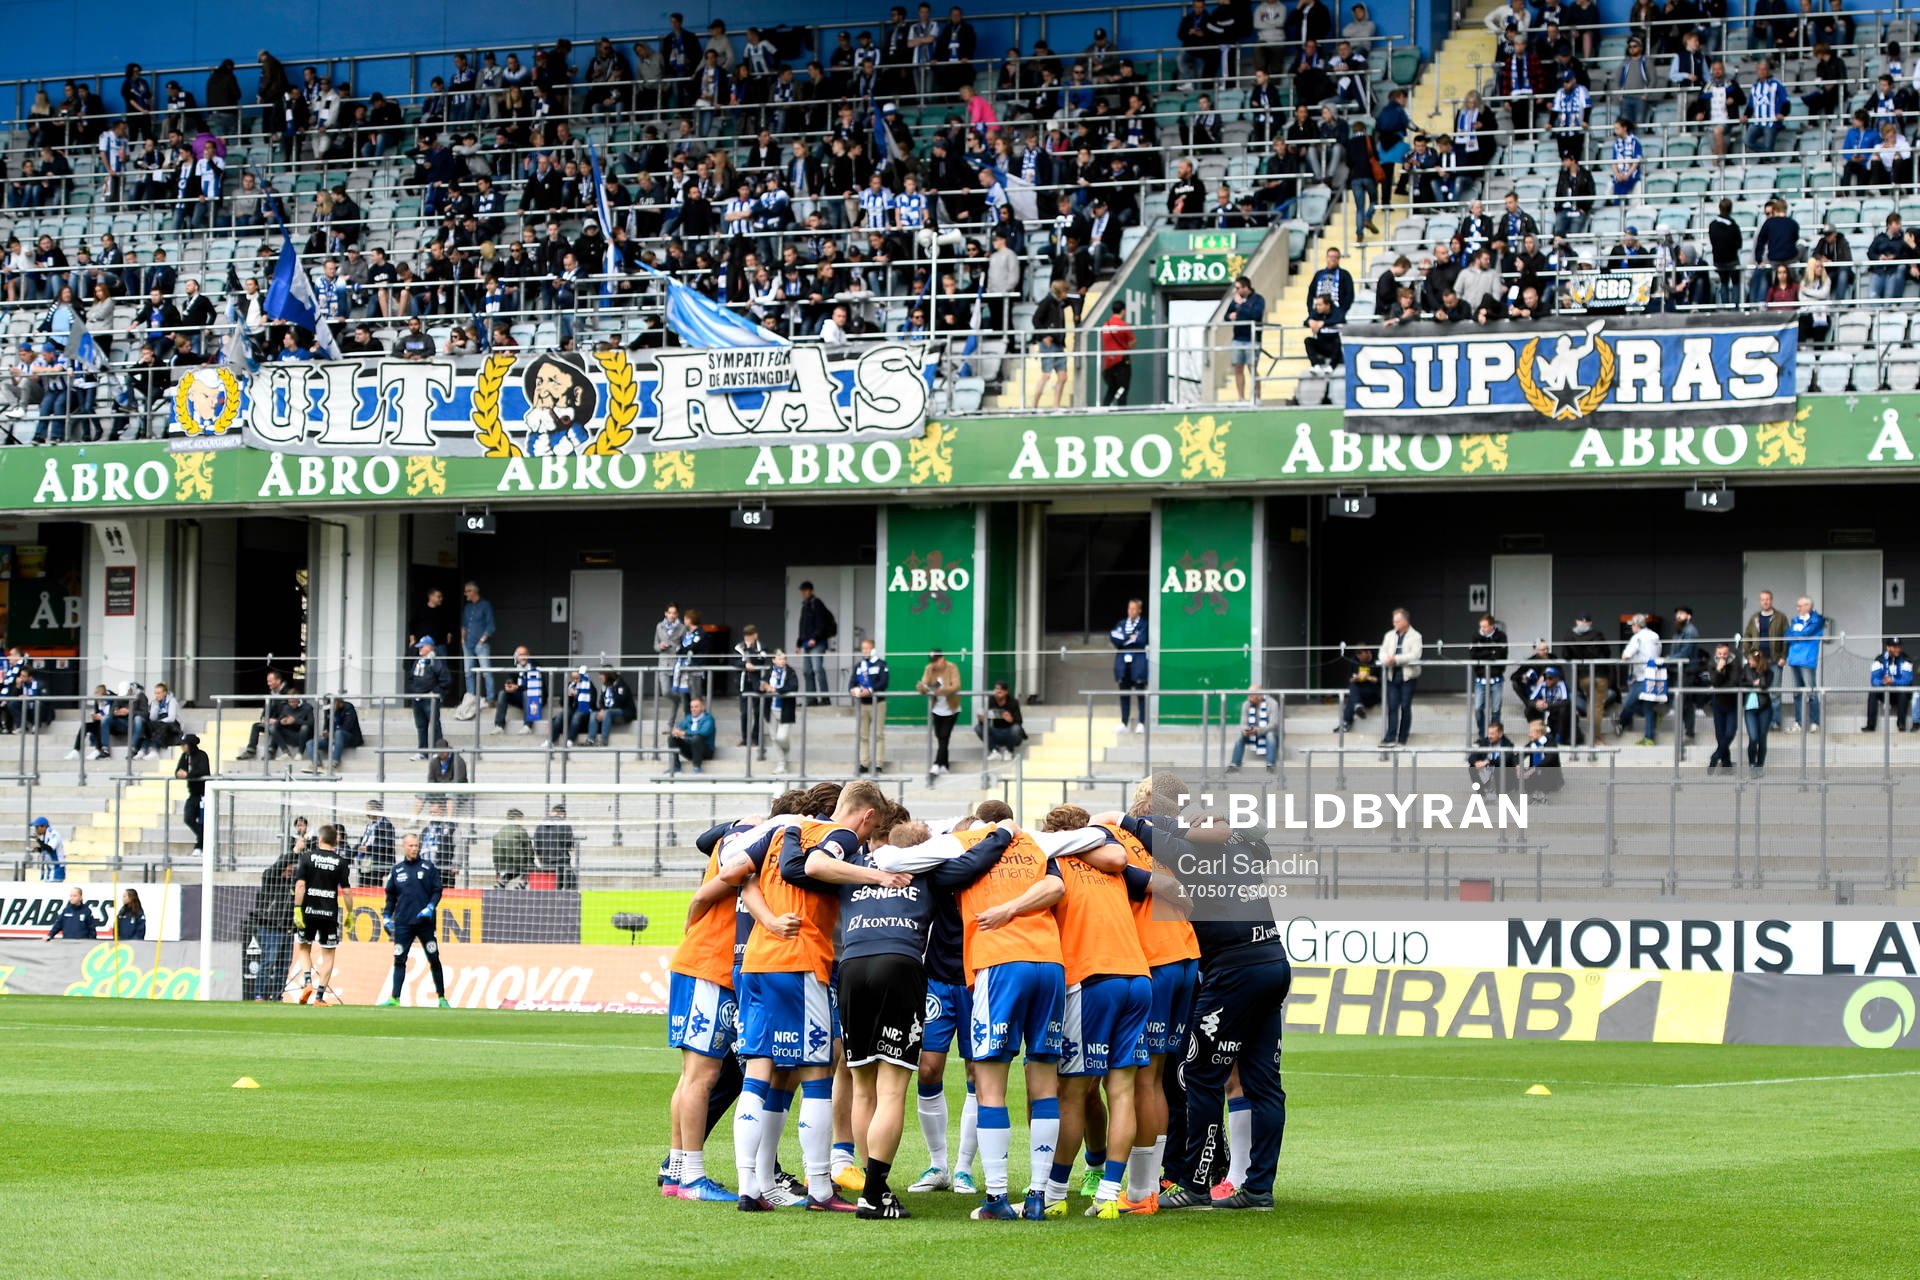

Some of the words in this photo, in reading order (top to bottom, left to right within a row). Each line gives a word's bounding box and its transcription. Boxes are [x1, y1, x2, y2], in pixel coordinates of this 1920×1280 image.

[708, 351, 764, 369] SYMPATI
[709, 373, 720, 387] DE
[1355, 339, 1517, 408] SUP
[1615, 335, 1780, 402] RAS
[1008, 430, 1173, 479] ÅBRO
[1281, 423, 1453, 473] ÅBRO
[33, 458, 169, 502] ÅBRO
[258, 452, 400, 497] ÅBRO
[467, 517, 484, 529] G4
[888, 566, 969, 592] ÅBRO
[1161, 566, 1246, 593] ÅBRO
[30, 591, 81, 629] ÅB
[1286, 916, 1429, 965] Group
[1507, 917, 1793, 974] MORRIS
[1822, 921, 1920, 976] LA
[771, 1045, 802, 1060] Group
[774, 1031, 799, 1043] NRC
[1193, 1124, 1218, 1185] Kappa
